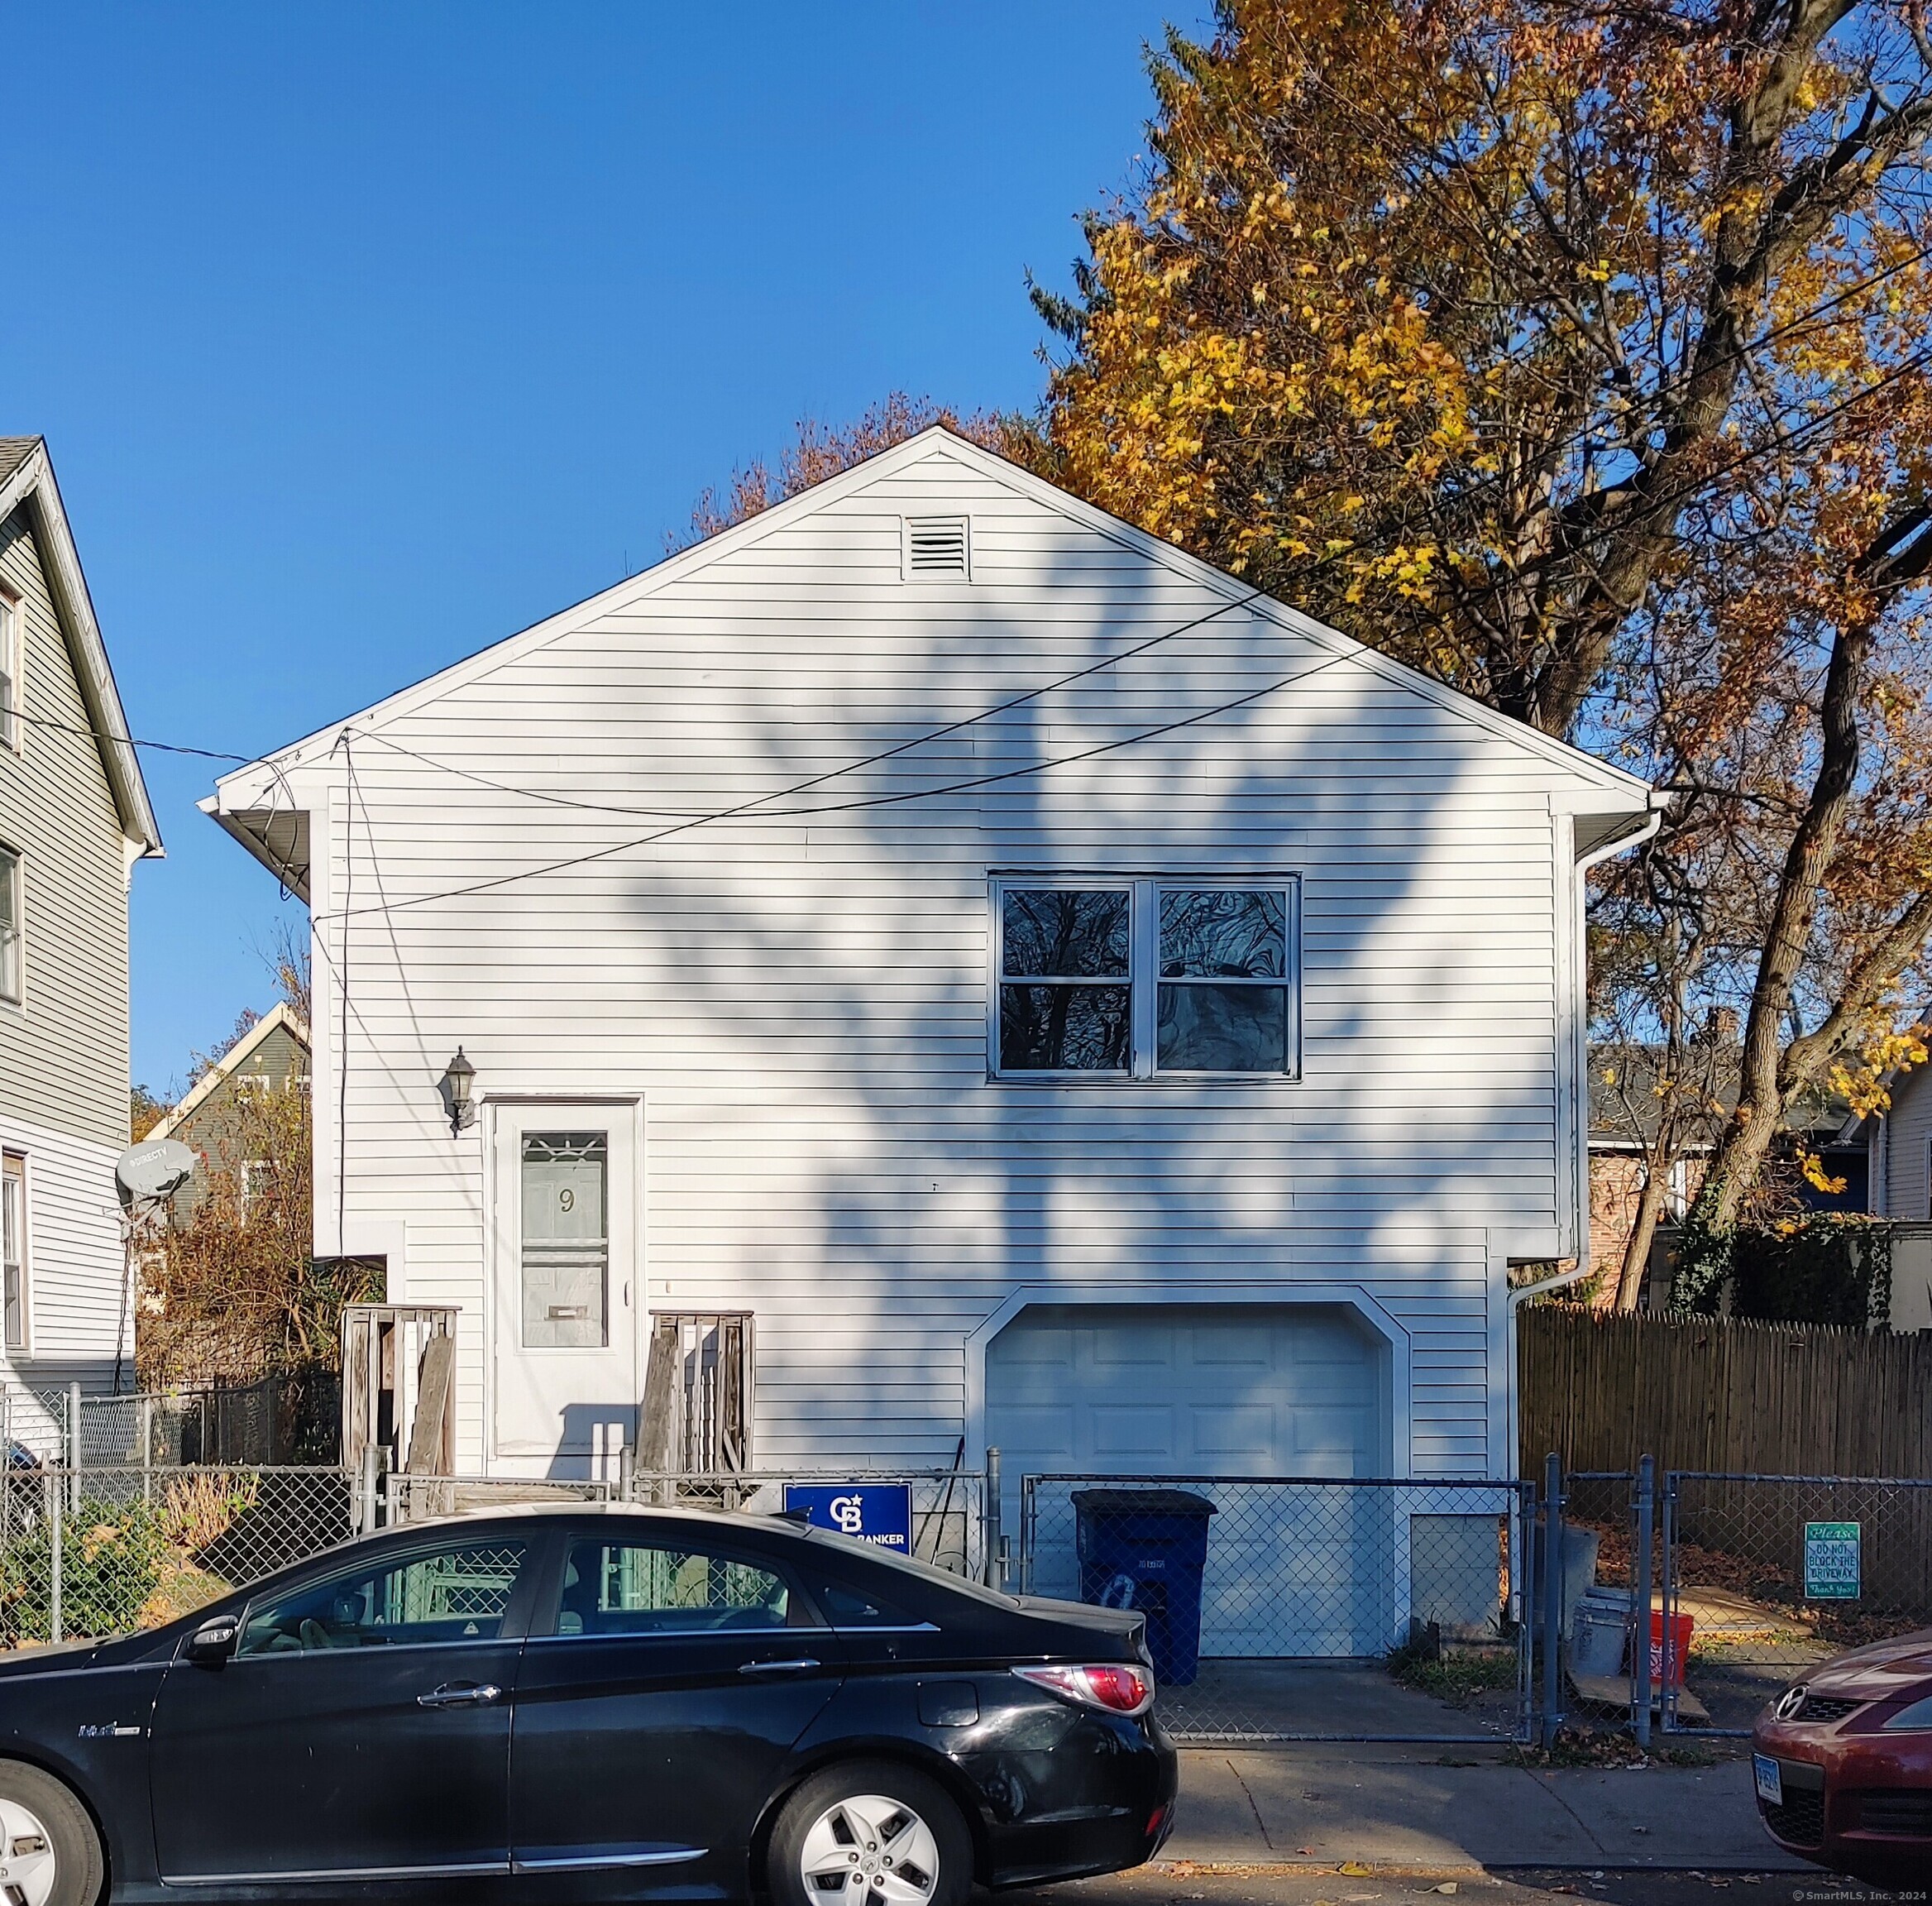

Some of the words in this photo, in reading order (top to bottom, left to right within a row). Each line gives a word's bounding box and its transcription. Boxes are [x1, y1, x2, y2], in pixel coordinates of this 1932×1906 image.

[135, 1146, 167, 1166] DIRECTV
[559, 1188, 575, 1213] 9
[830, 1497, 863, 1533] CB
[1810, 1526, 1854, 1539] Please
[1816, 1544, 1829, 1554] DO
[1831, 1544, 1848, 1554] NOT
[1809, 1556, 1837, 1566] BLOCK
[1839, 1556, 1856, 1566] THE
[1811, 1568, 1853, 1578] DRIVEWAY
[1810, 1584, 1834, 1593] Thank
